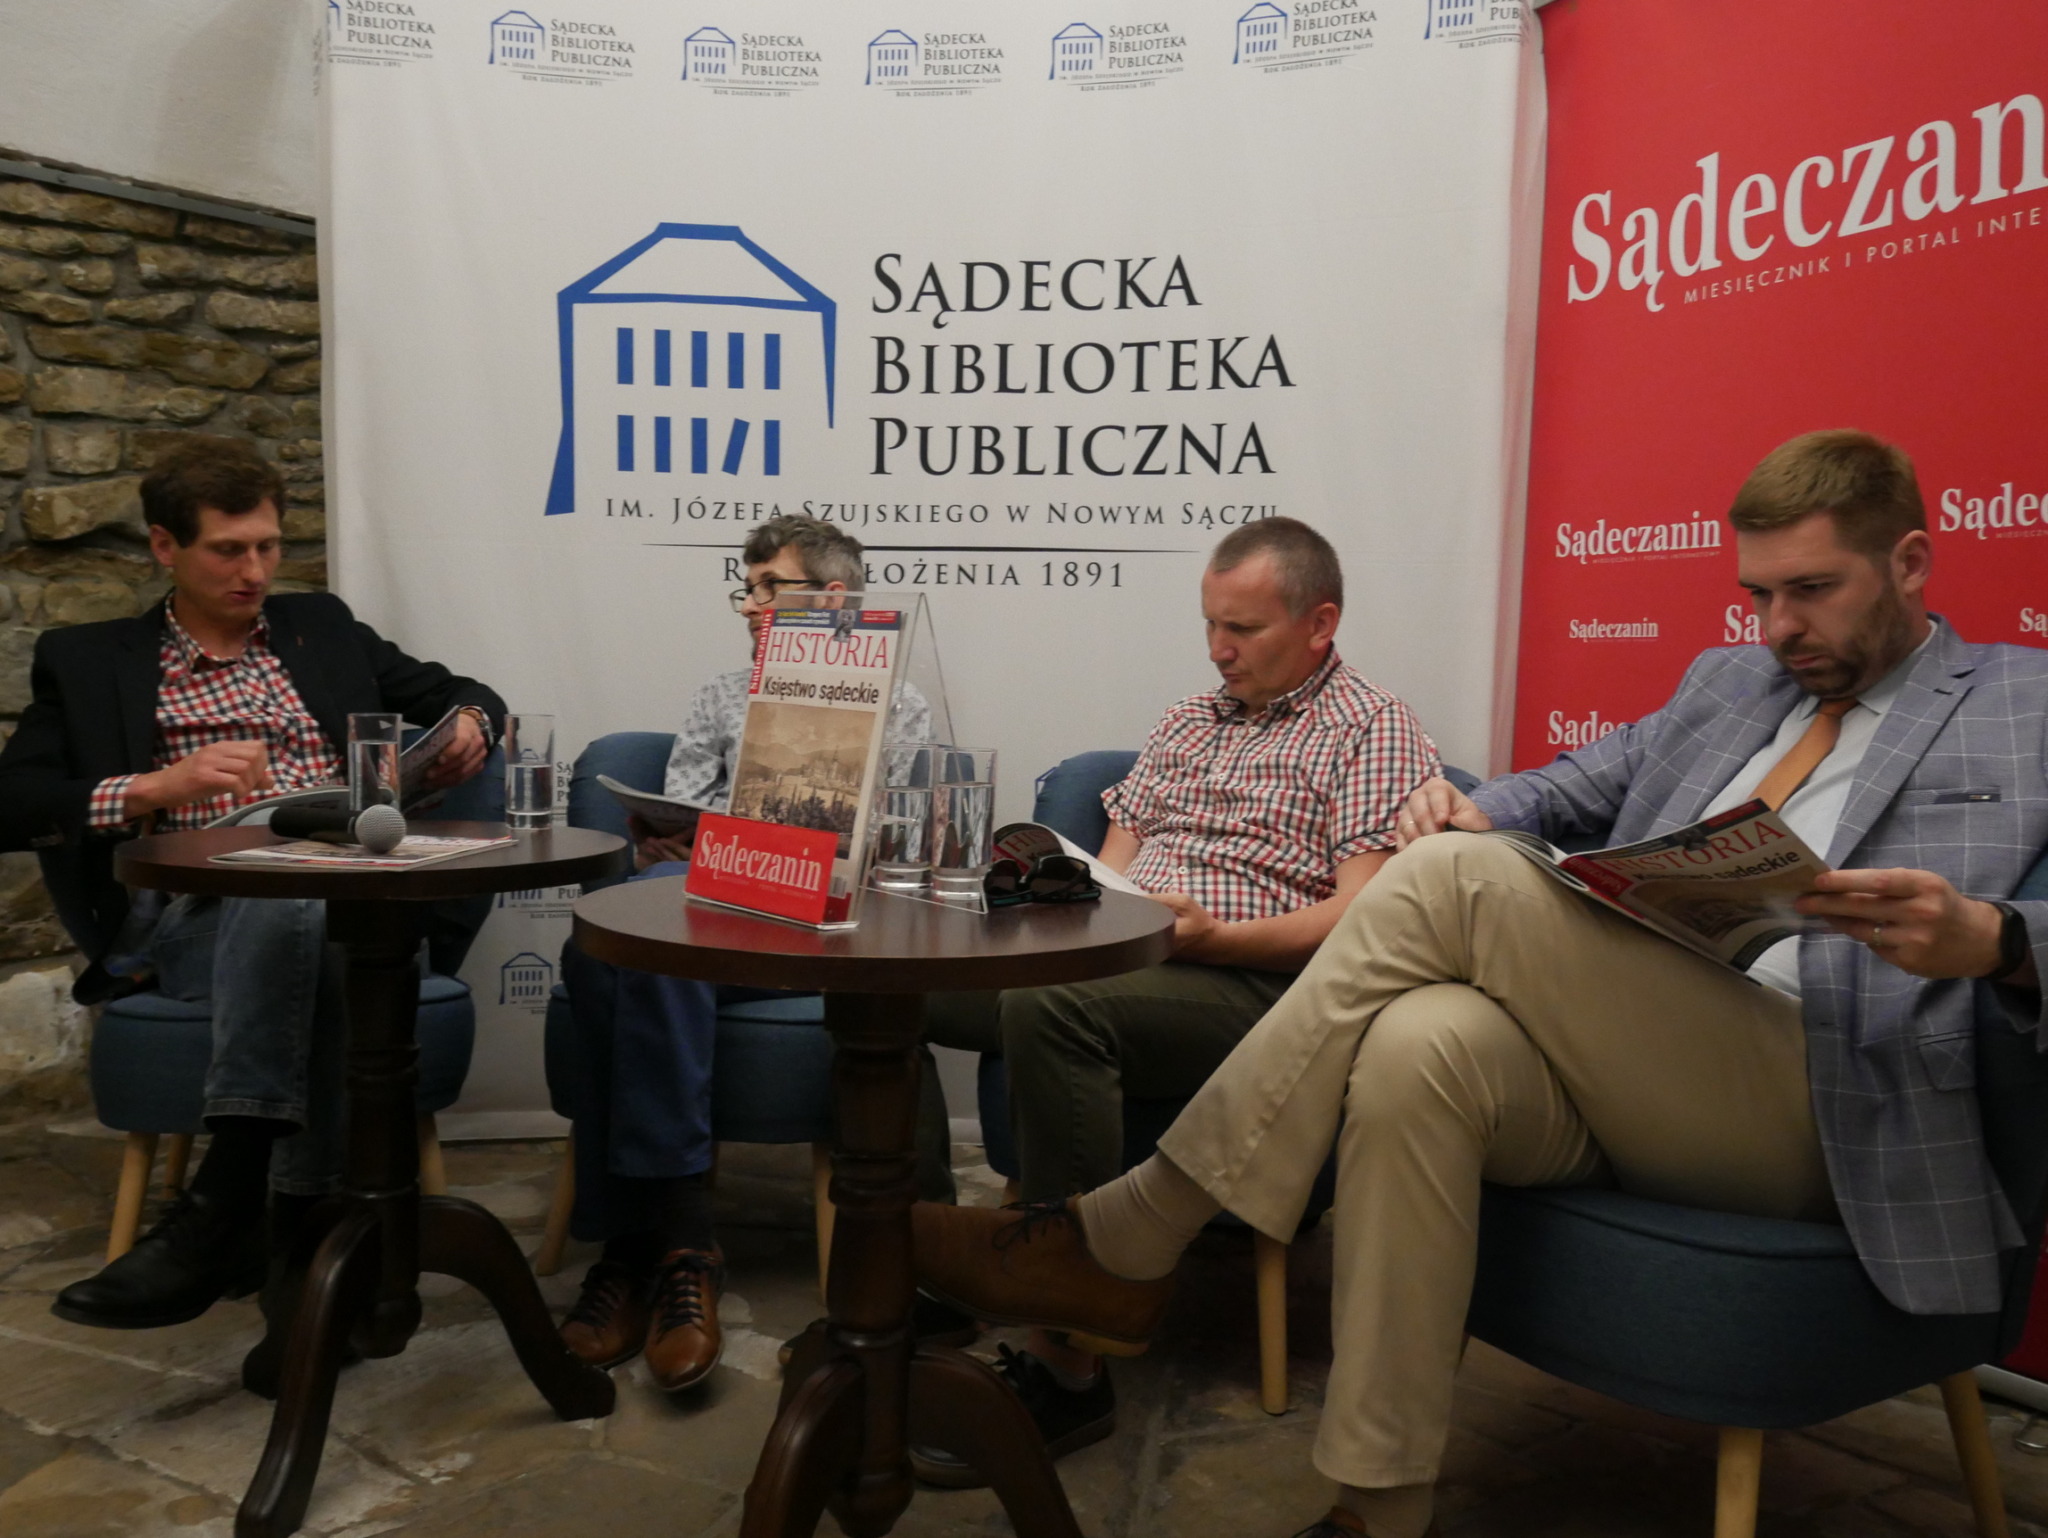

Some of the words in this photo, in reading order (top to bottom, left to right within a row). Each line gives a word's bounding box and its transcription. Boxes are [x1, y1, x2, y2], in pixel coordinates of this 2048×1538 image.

[347, 13, 435, 34] BIBLIOTEKA
[551, 19, 616, 36] SĄDECKA
[1109, 22, 1169, 40] SĄDECKA
[1294, 10, 1377, 32] BIBLIOTEKA
[347, 29, 432, 49] PUBLICZNA
[551, 34, 635, 53] BIBLIOTEKA
[741, 33, 804, 48] SĄDECKA
[924, 33, 986, 48] SĄDECKA
[1109, 36, 1187, 53] BIBLIOTEKA
[1292, 28, 1373, 48] PUBLICZNA
[551, 50, 632, 68] PUBLICZNA
[742, 48, 822, 62] BIBLIOTEKA
[924, 48, 1004, 61] BIBLIOTEKA
[1108, 52, 1183, 69] PUBLICZNA
[742, 63, 819, 77] PUBLICZNA
[924, 63, 1001, 76] PUBLICZNA
[1683, 256, 1831, 304] MIESIĘCZNIK
[1845, 252, 1851, 268] I
[1867, 226, 1960, 262] PORTAL
[1977, 207, 2042, 238] INTE
[872, 253, 1202, 330] SĄDECKA
[870, 333, 1296, 395] BIBLIOTEKA
[869, 416, 1276, 476] PUBLICZNA
[606, 498, 653, 518] IM.
[672, 496, 782, 524] JÓZEFA
[803, 500, 989, 527] SZUJSKIEGO
[1007, 504, 1030, 523] W
[1047, 502, 1165, 525] NOWYM
[1555, 510, 1721, 565] Sądeczanin
[864, 559, 1020, 586] ŁOŻENIA
[1042, 562, 1122, 587] 1891
[1569, 617, 1659, 643] Sądeczanin
[768, 632, 888, 668] HISTORIA
[763, 676, 816, 700] Księstwo
[819, 680, 879, 705] sądeckie
[1548, 711, 1620, 751] Sąde
[1601, 820, 1786, 871] HISTORIA
[696, 830, 822, 891] Sądeczanin
